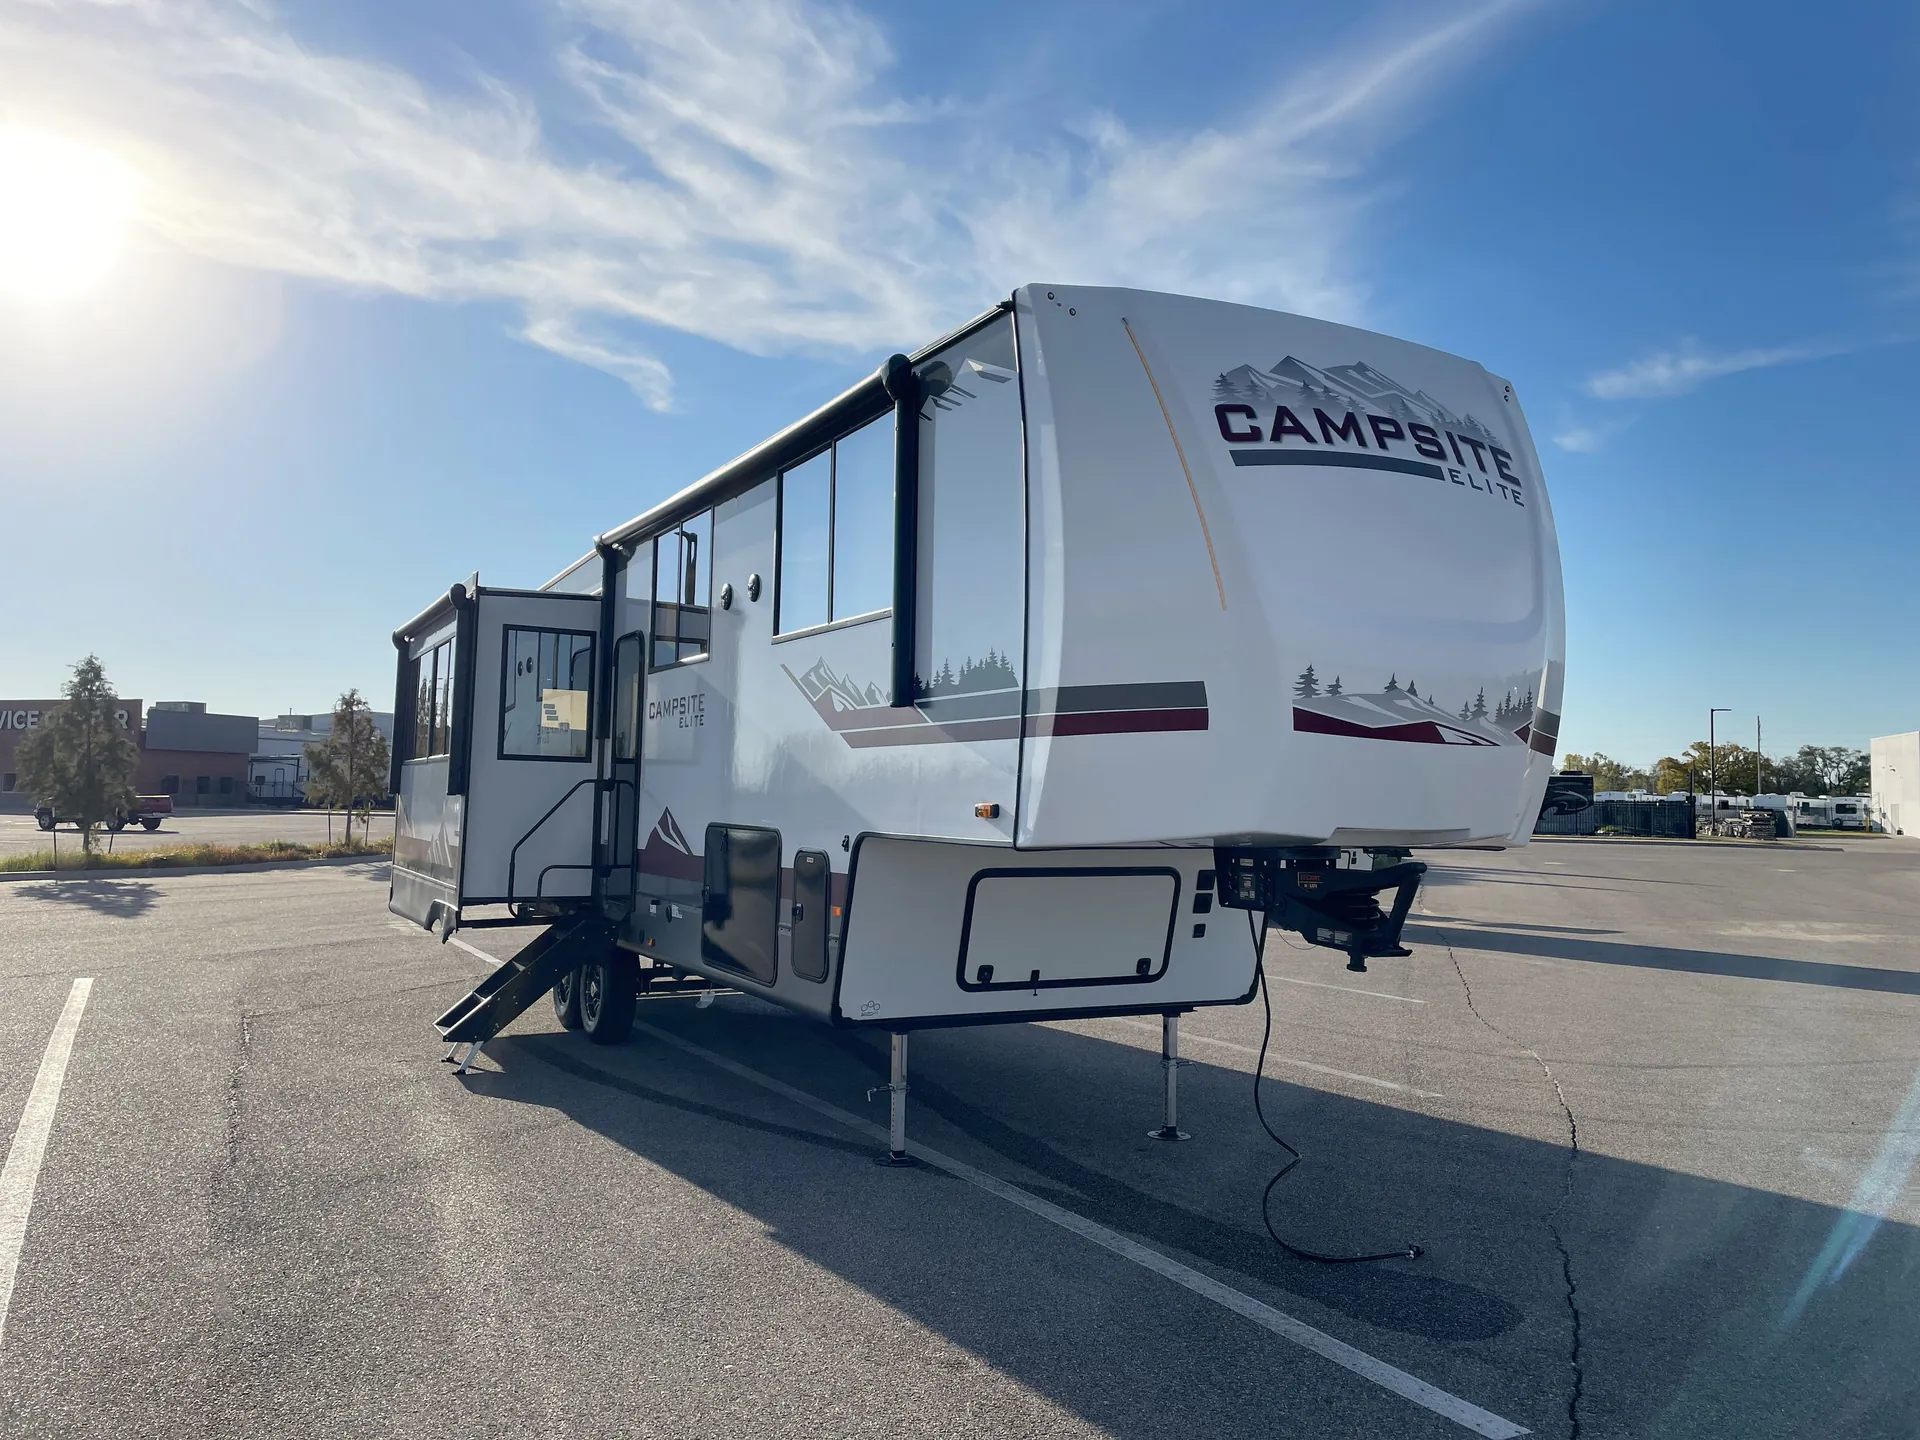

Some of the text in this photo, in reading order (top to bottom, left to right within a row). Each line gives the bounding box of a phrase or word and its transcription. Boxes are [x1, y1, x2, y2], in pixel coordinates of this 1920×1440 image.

[1214, 403, 1522, 488] CAMPSITE
[1447, 467, 1525, 507] ELITE
[649, 693, 705, 719] CAMPSITE
[679, 714, 704, 729] ELITE
